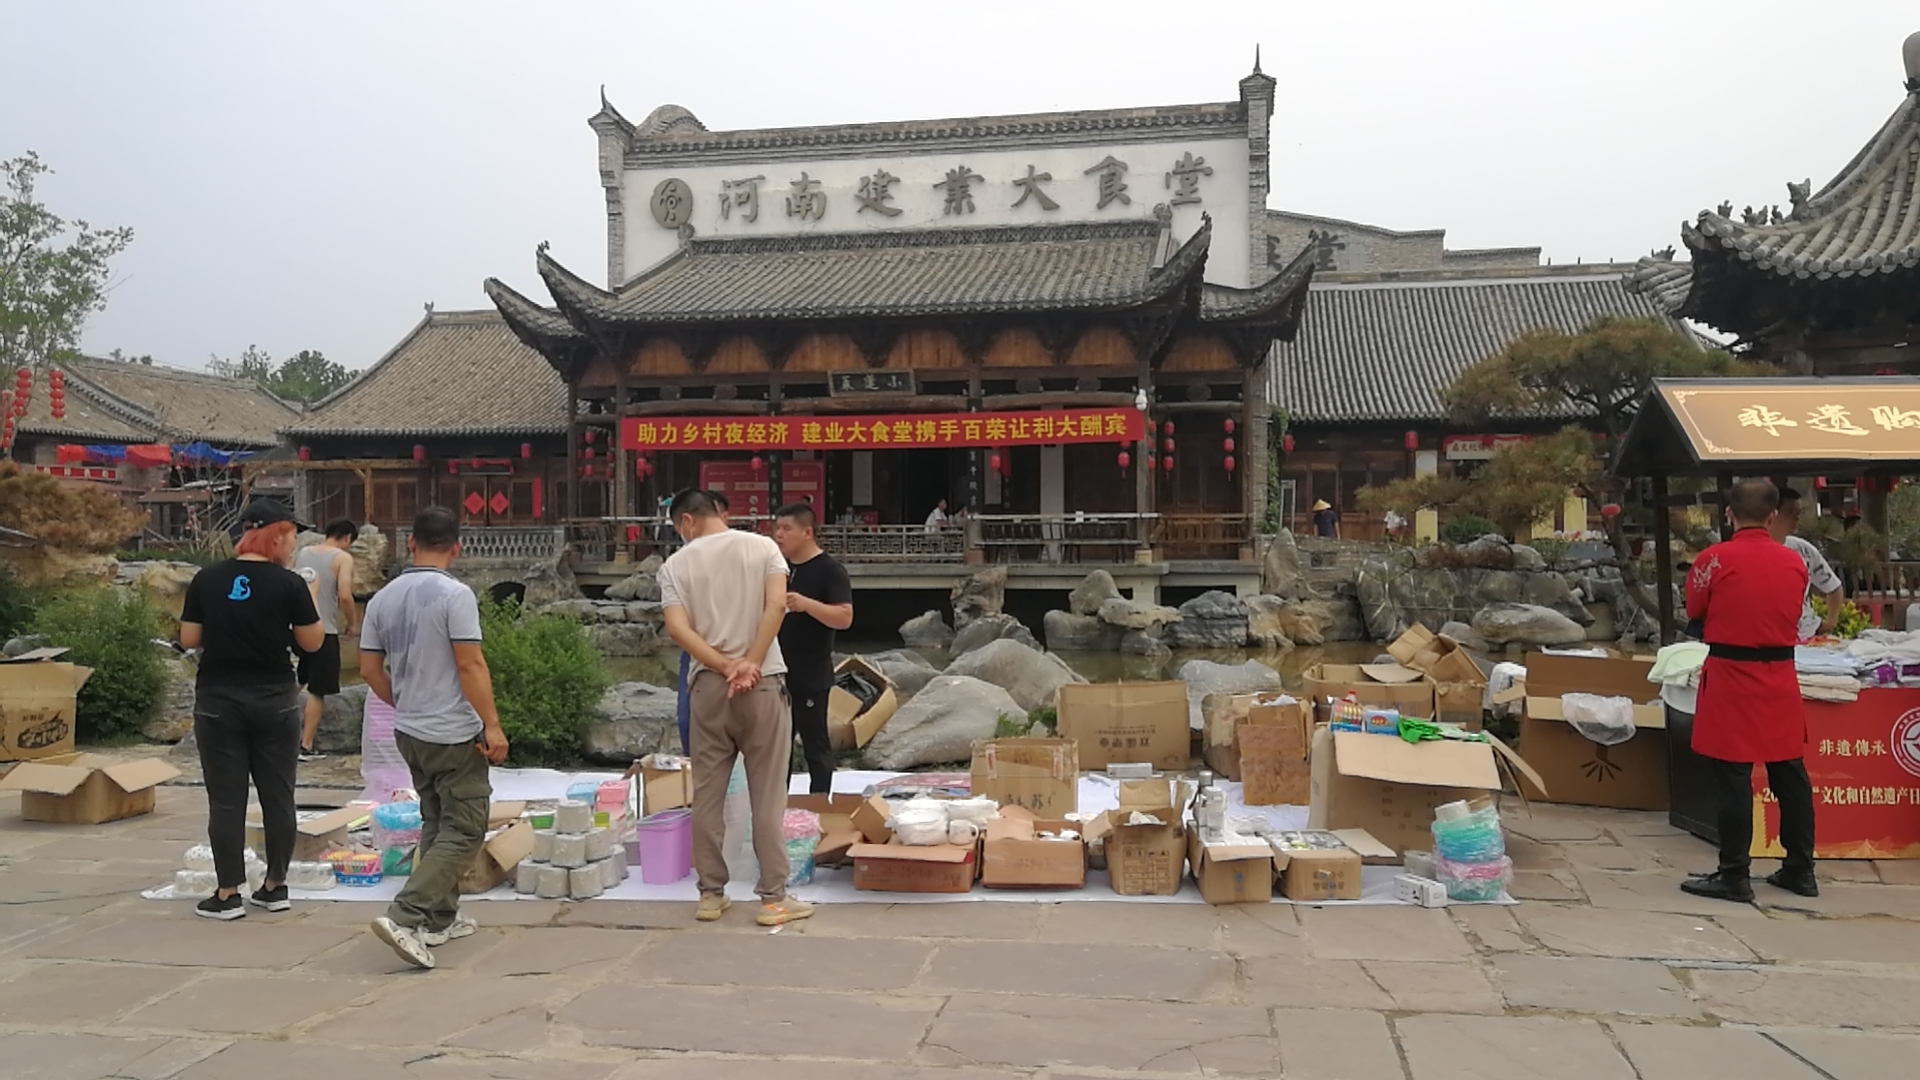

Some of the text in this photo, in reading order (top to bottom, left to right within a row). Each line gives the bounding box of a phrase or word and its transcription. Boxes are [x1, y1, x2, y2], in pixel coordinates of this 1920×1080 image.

[718, 151, 1214, 222] 河南建業大食堂
[637, 413, 1128, 445] 助力乡村夜经济 建业大食堂携手百荣让利大酬宾
